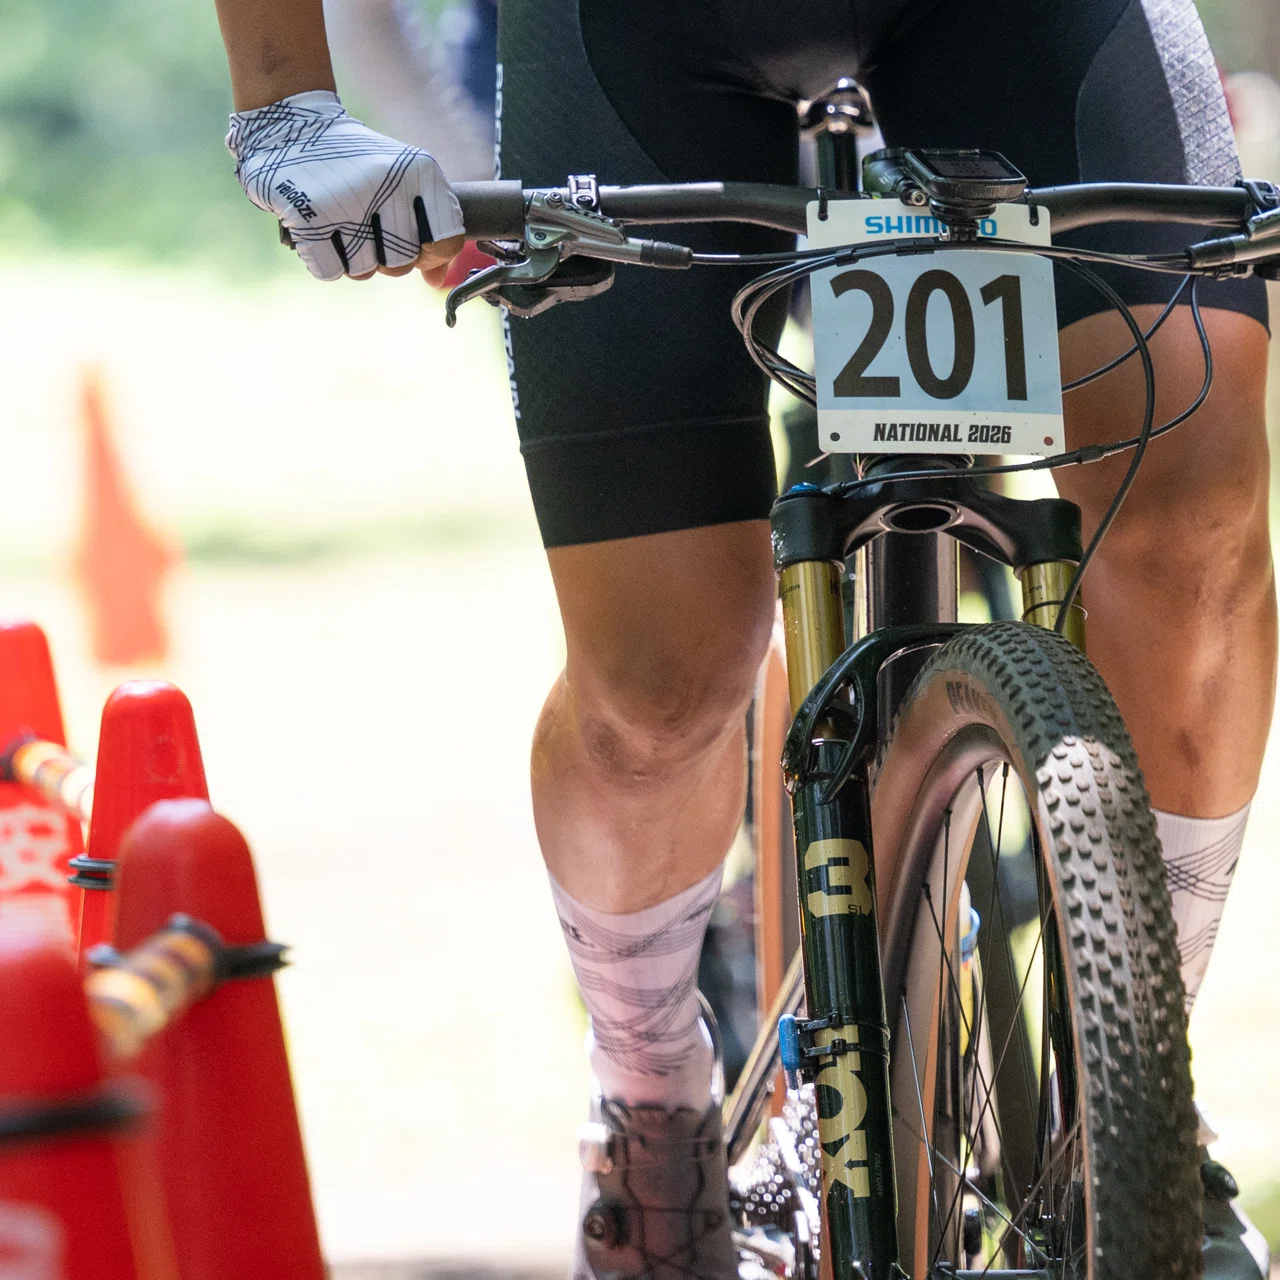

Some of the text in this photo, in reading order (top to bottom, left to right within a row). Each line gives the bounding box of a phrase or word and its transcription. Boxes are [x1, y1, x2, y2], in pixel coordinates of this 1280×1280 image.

[864, 215, 998, 237] SHIMO
[829, 269, 1028, 401] 201
[873, 423, 1012, 444] NATIONAL 2026
